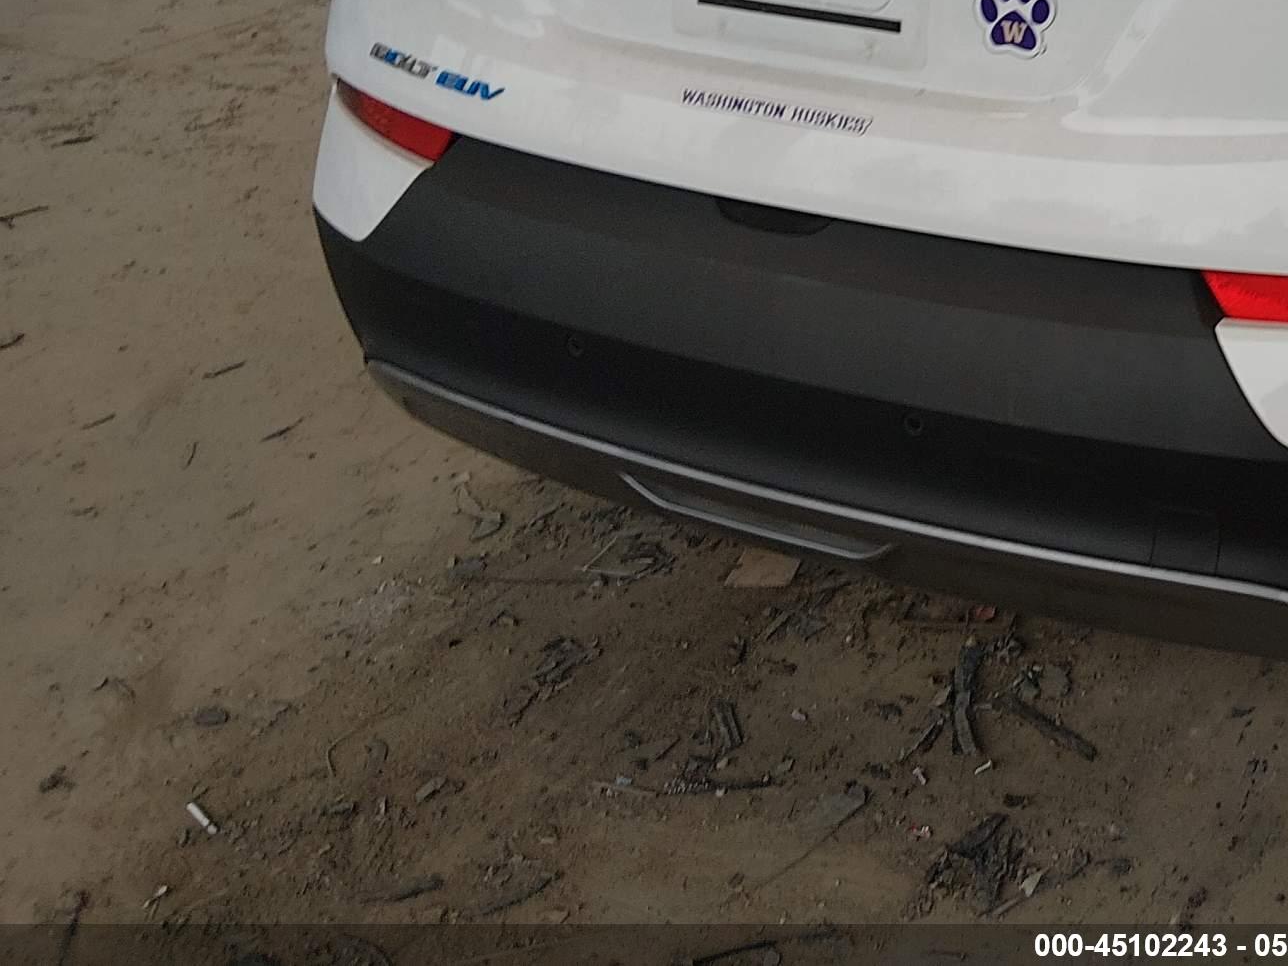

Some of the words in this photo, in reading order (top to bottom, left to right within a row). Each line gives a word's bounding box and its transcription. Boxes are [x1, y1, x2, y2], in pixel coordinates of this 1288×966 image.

[1000, 19, 1027, 44] W
[369, 42, 438, 80] BOLT
[435, 70, 505, 100] EUV
[682, 88, 787, 119] WASHINGTON
[790, 105, 866, 135] HUSKIES
